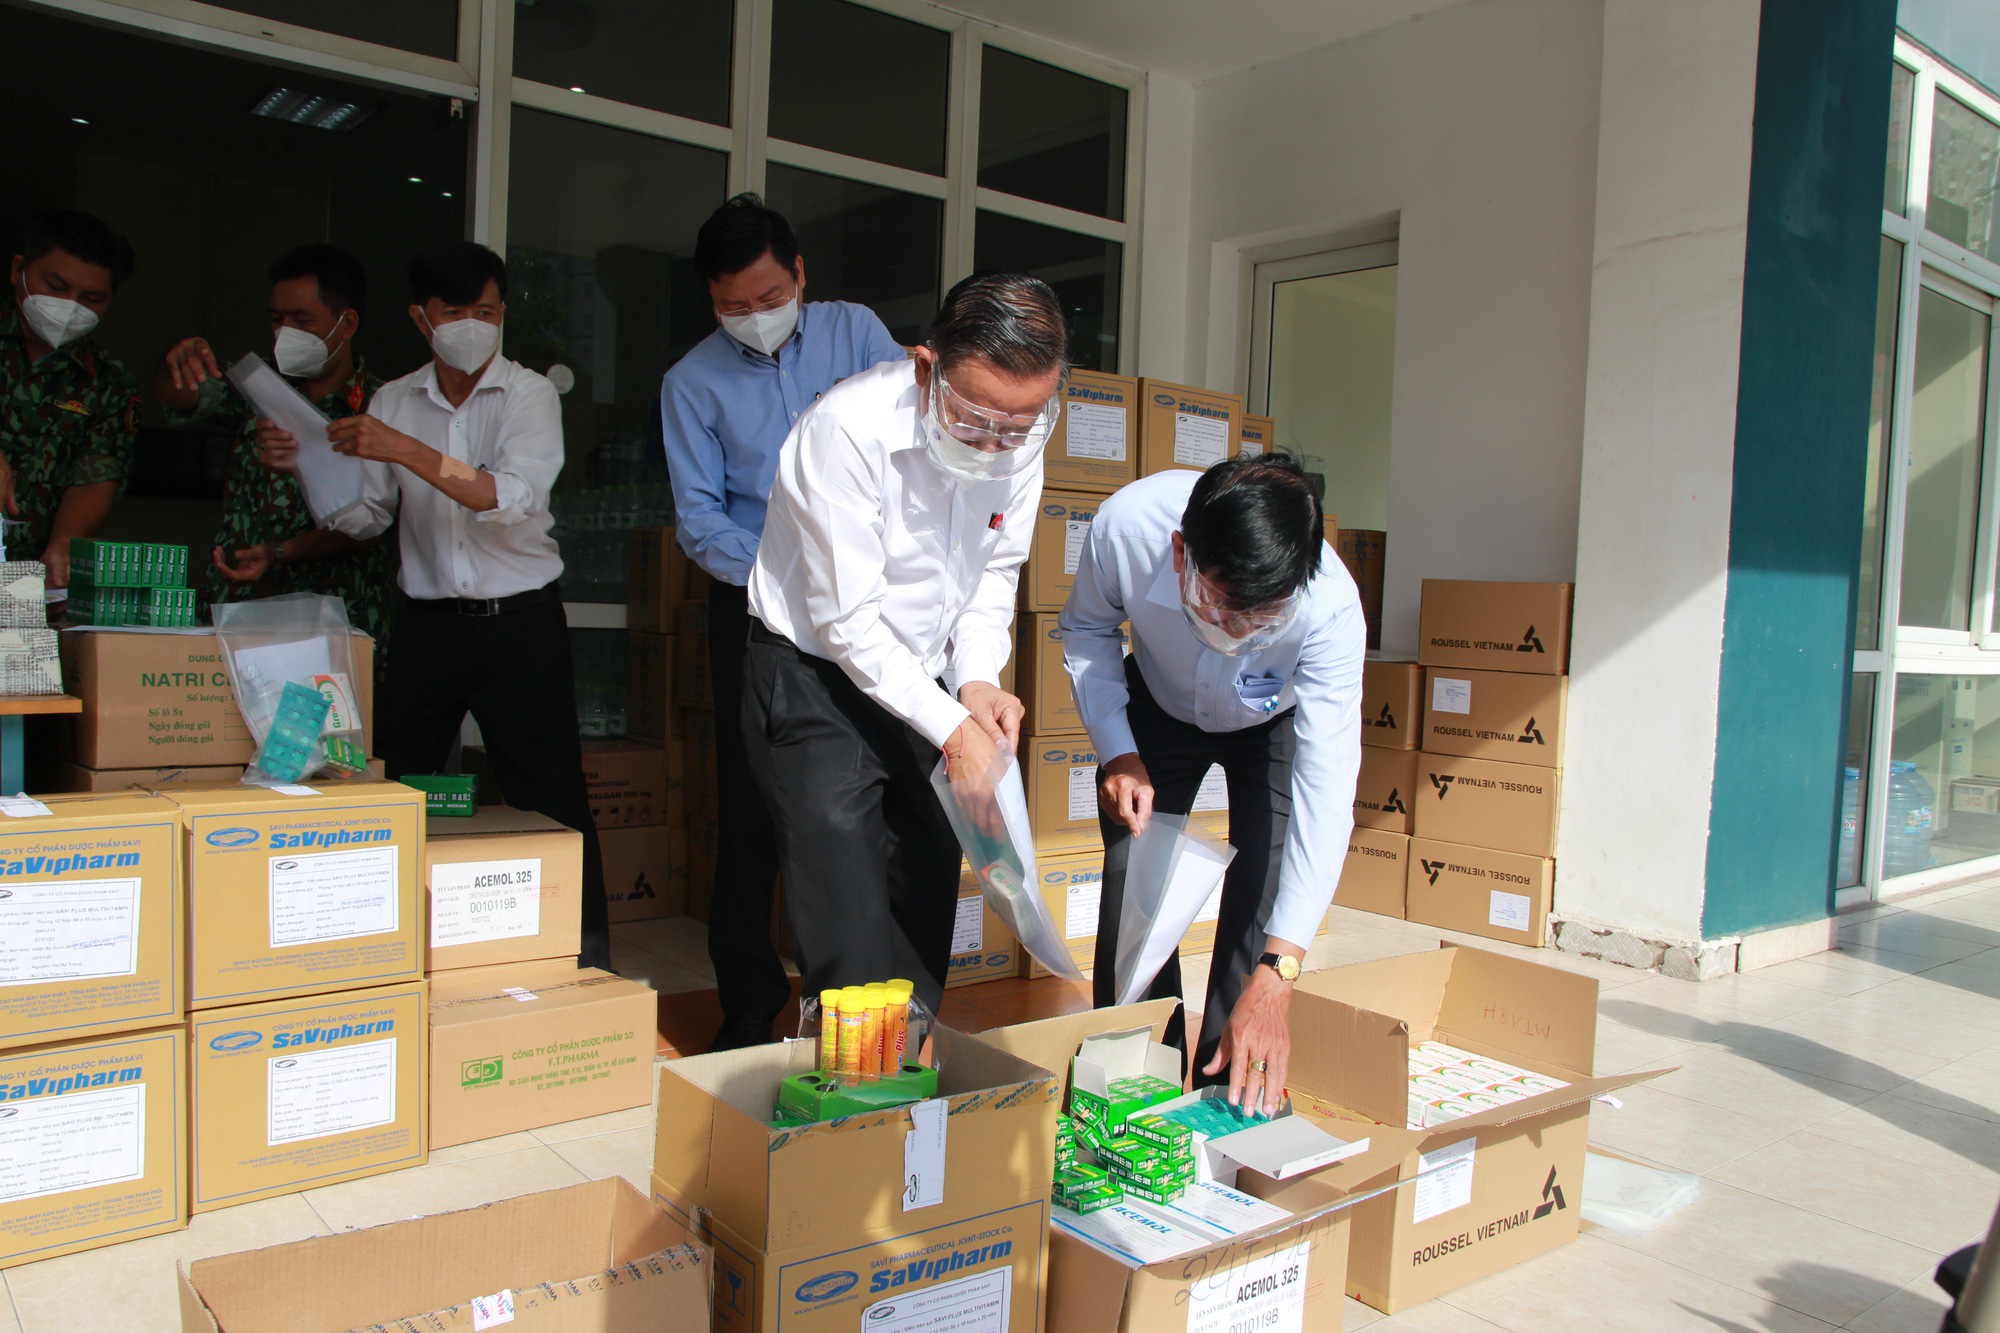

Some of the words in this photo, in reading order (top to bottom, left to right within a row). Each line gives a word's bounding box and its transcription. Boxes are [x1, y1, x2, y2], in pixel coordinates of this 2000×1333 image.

[1068, 387, 1123, 403] SaVipharm
[1179, 402, 1229, 419] SaVipharm
[1431, 638, 1471, 648] ROUSSEL
[1474, 641, 1513, 651] VIETNAM
[142, 673, 204, 687] NATRI
[187, 693, 198, 701] Số
[148, 708, 160, 716] Số
[162, 708, 170, 716] lô
[173, 708, 183, 716] Sx
[148, 722, 171, 731] Ngày
[174, 722, 195, 730] đóng
[197, 721, 210, 730] gói
[1433, 726, 1473, 737] ROUSSEL
[1476, 731, 1514, 741] VIETNAM
[148, 736, 174, 745] Người
[201, 734, 214, 743] gói
[1458, 777, 1496, 788] VIETNAM
[1500, 781, 1542, 794] ROUSSEL
[588, 792, 621, 800] RALGAN
[1353, 800, 1379, 811] ETNAM
[285, 820, 342, 830] PHARMACEUTICAL
[343, 817, 381, 826] JOINT-STOCK
[269, 828, 392, 849] SaVipharm
[1361, 847, 1397, 860] ROUSSEL
[0, 853, 140, 876] SaVipharm
[1448, 864, 1485, 877] VIETNAM
[474, 873, 513, 888] ACEMOL
[516, 871, 532, 883] 325
[1489, 870, 1530, 885] ROUSSEL
[470, 897, 516, 913] 0010119B
[471, 915, 490, 924] 100722
[272, 1023, 295, 1031] CÔNG
[380, 1008, 395, 1016] SAVI
[272, 1019, 394, 1049] SaVipharm
[895, 1030, 906, 1053] Plus
[512, 1049, 534, 1060] CÔNG
[535, 1047, 545, 1056] TY
[581, 1037, 601, 1048] DƯỢC
[602, 1031, 623, 1043] PHẨM
[624, 1031, 634, 1040] 3/2
[125, 1054, 143, 1062] SAVI
[548, 1050, 599, 1067] F.T.PHARMA
[0, 1067, 142, 1101] SaVipharm
[473, 1081, 500, 1089] PHARMA
[948, 1094, 980, 1116] Vipharm
[1313, 1104, 1336, 1118] ROUSSEL
[1199, 1182, 1258, 1207] ACEMOL
[1110, 1206, 1173, 1234] ACEMOL
[1413, 1232, 1473, 1267] ROUSSEL
[1477, 1209, 1529, 1242] VIETNAM
[870, 1257, 888, 1269] SAVI
[889, 1240, 956, 1264] PHARMACEUTICAL
[957, 1229, 1000, 1246] JOINT-STOCK
[1002, 1226, 1014, 1234] Co.
[869, 1240, 1012, 1294] SaVipharm
[1236, 1273, 1278, 1304] ACEMOL
[1281, 1264, 1299, 1287] 325
[934, 1316, 947, 1324] SAVI
[948, 1311, 962, 1320] PLUS
[963, 1299, 999, 1315] MULTIVITAMIN
[1229, 1308, 1279, 1333] 0010119B
